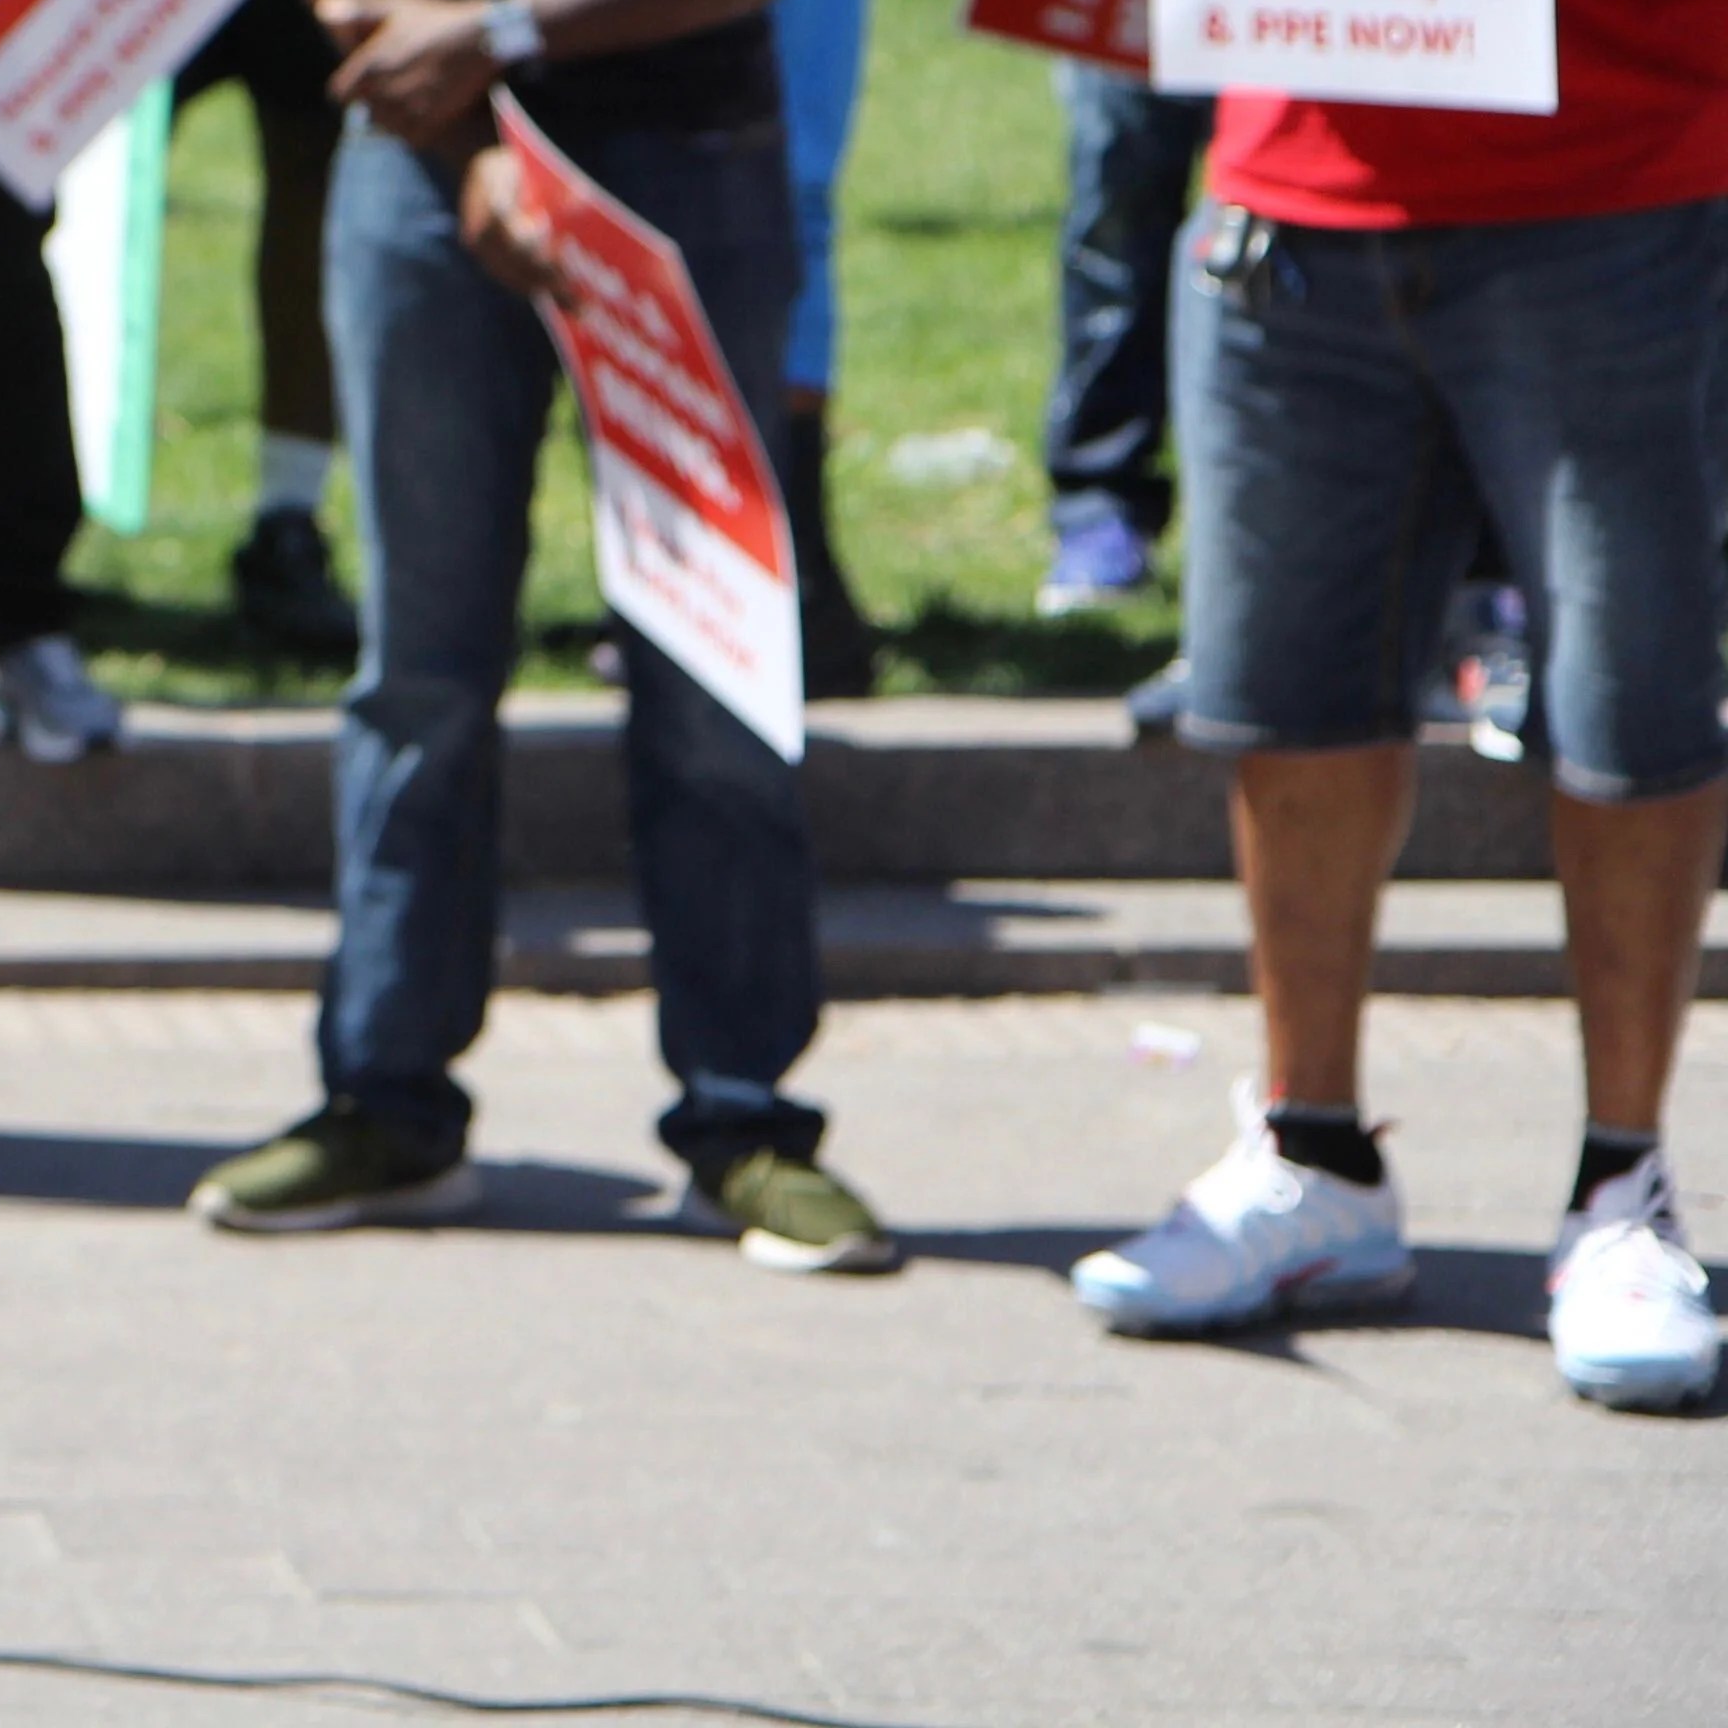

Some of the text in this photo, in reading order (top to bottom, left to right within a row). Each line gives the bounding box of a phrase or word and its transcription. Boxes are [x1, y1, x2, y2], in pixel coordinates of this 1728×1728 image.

[1203, 3, 1475, 60] & PPE NOW!
